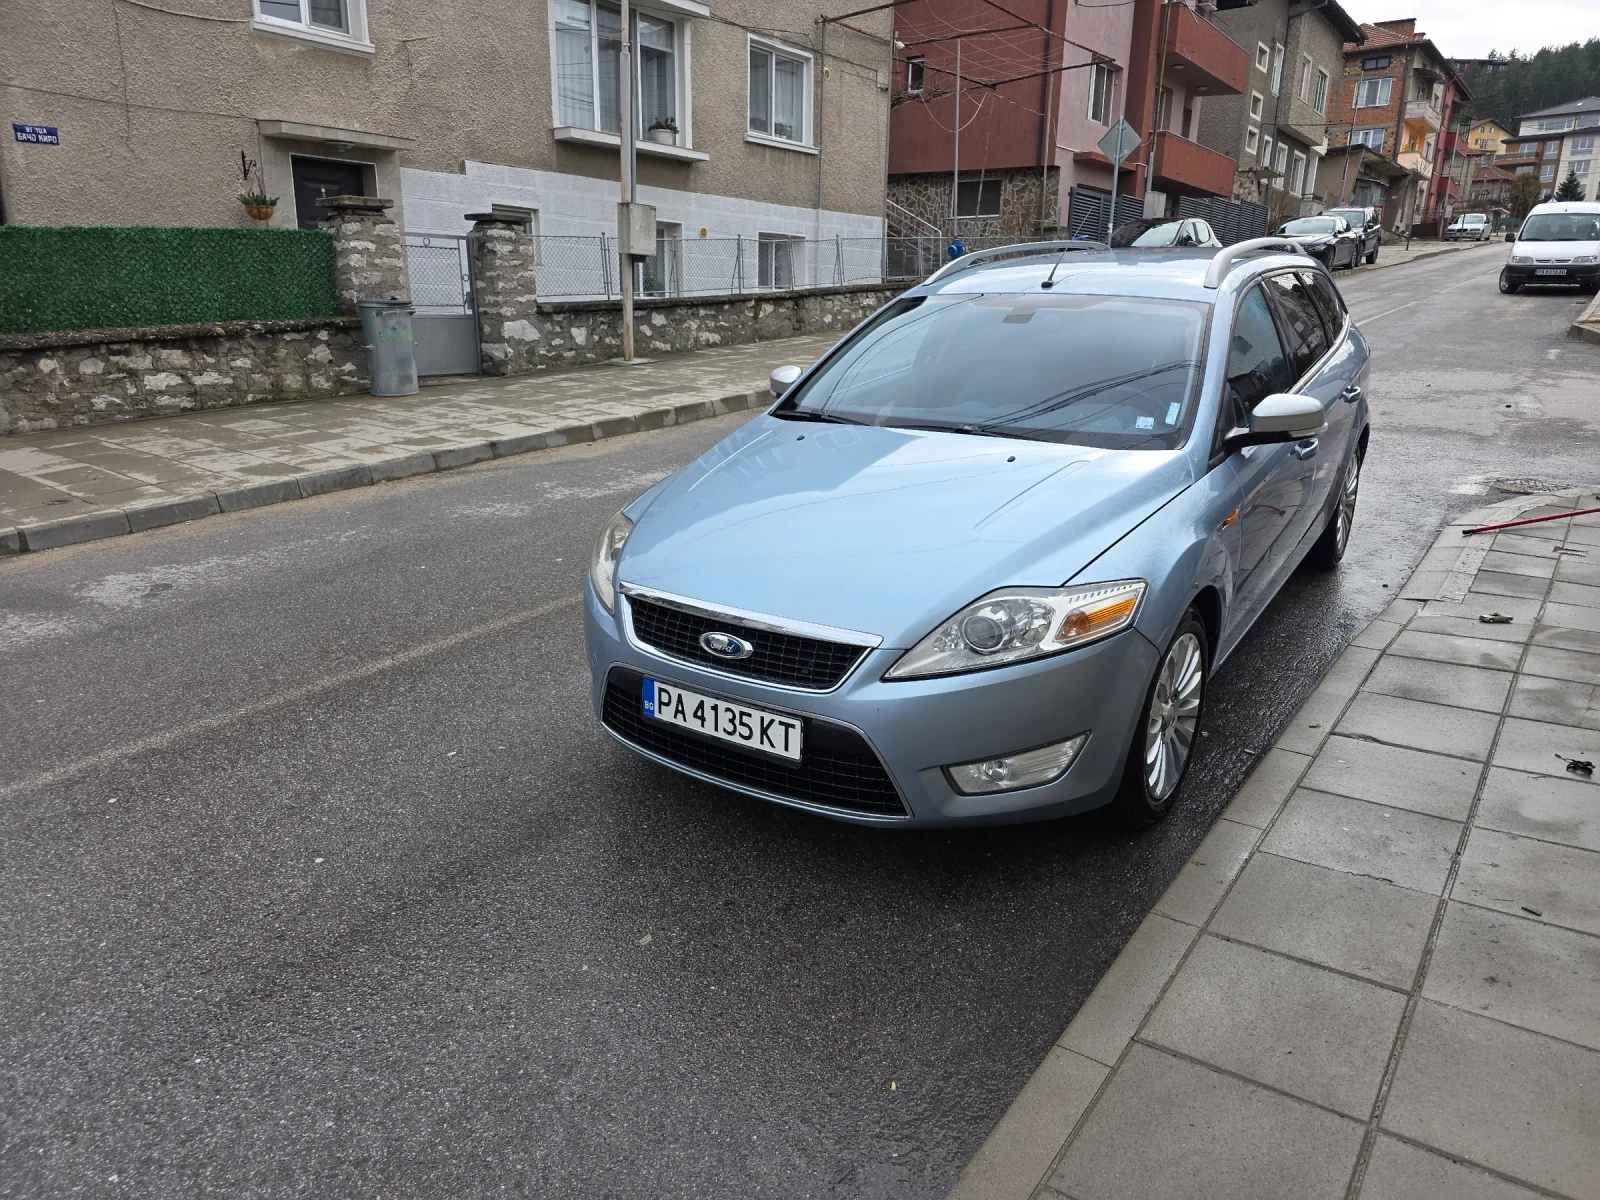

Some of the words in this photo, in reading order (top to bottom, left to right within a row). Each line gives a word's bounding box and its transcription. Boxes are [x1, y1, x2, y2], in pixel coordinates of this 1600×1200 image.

[17, 132, 36, 142] БАЧО
[38, 134, 57, 144] КИРО
[644, 700, 654, 711] BG
[657, 686, 687, 723] PA
[692, 699, 754, 741] 4135
[759, 715, 796, 752] KT
